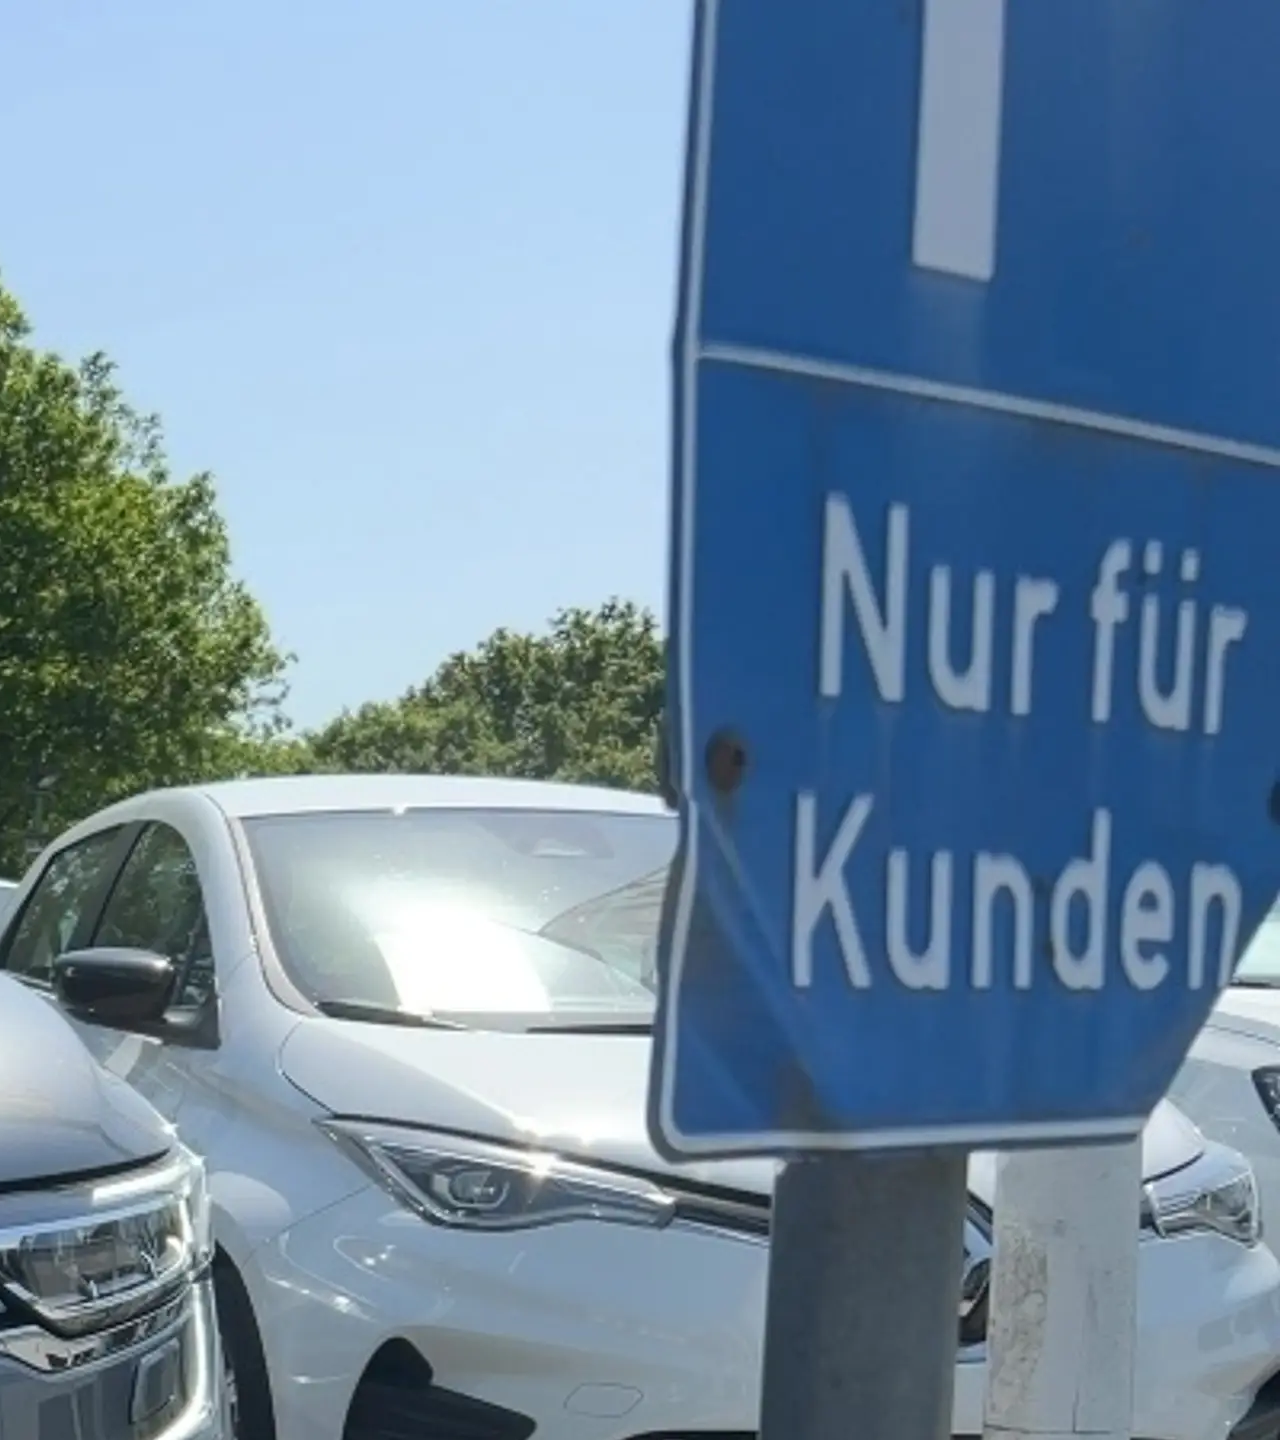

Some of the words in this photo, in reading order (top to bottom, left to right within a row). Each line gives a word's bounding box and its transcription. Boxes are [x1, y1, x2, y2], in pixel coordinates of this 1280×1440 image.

[819, 491, 1060, 716] Nur
[1090, 537, 1248, 735] für
[791, 790, 1244, 990] Kunden
